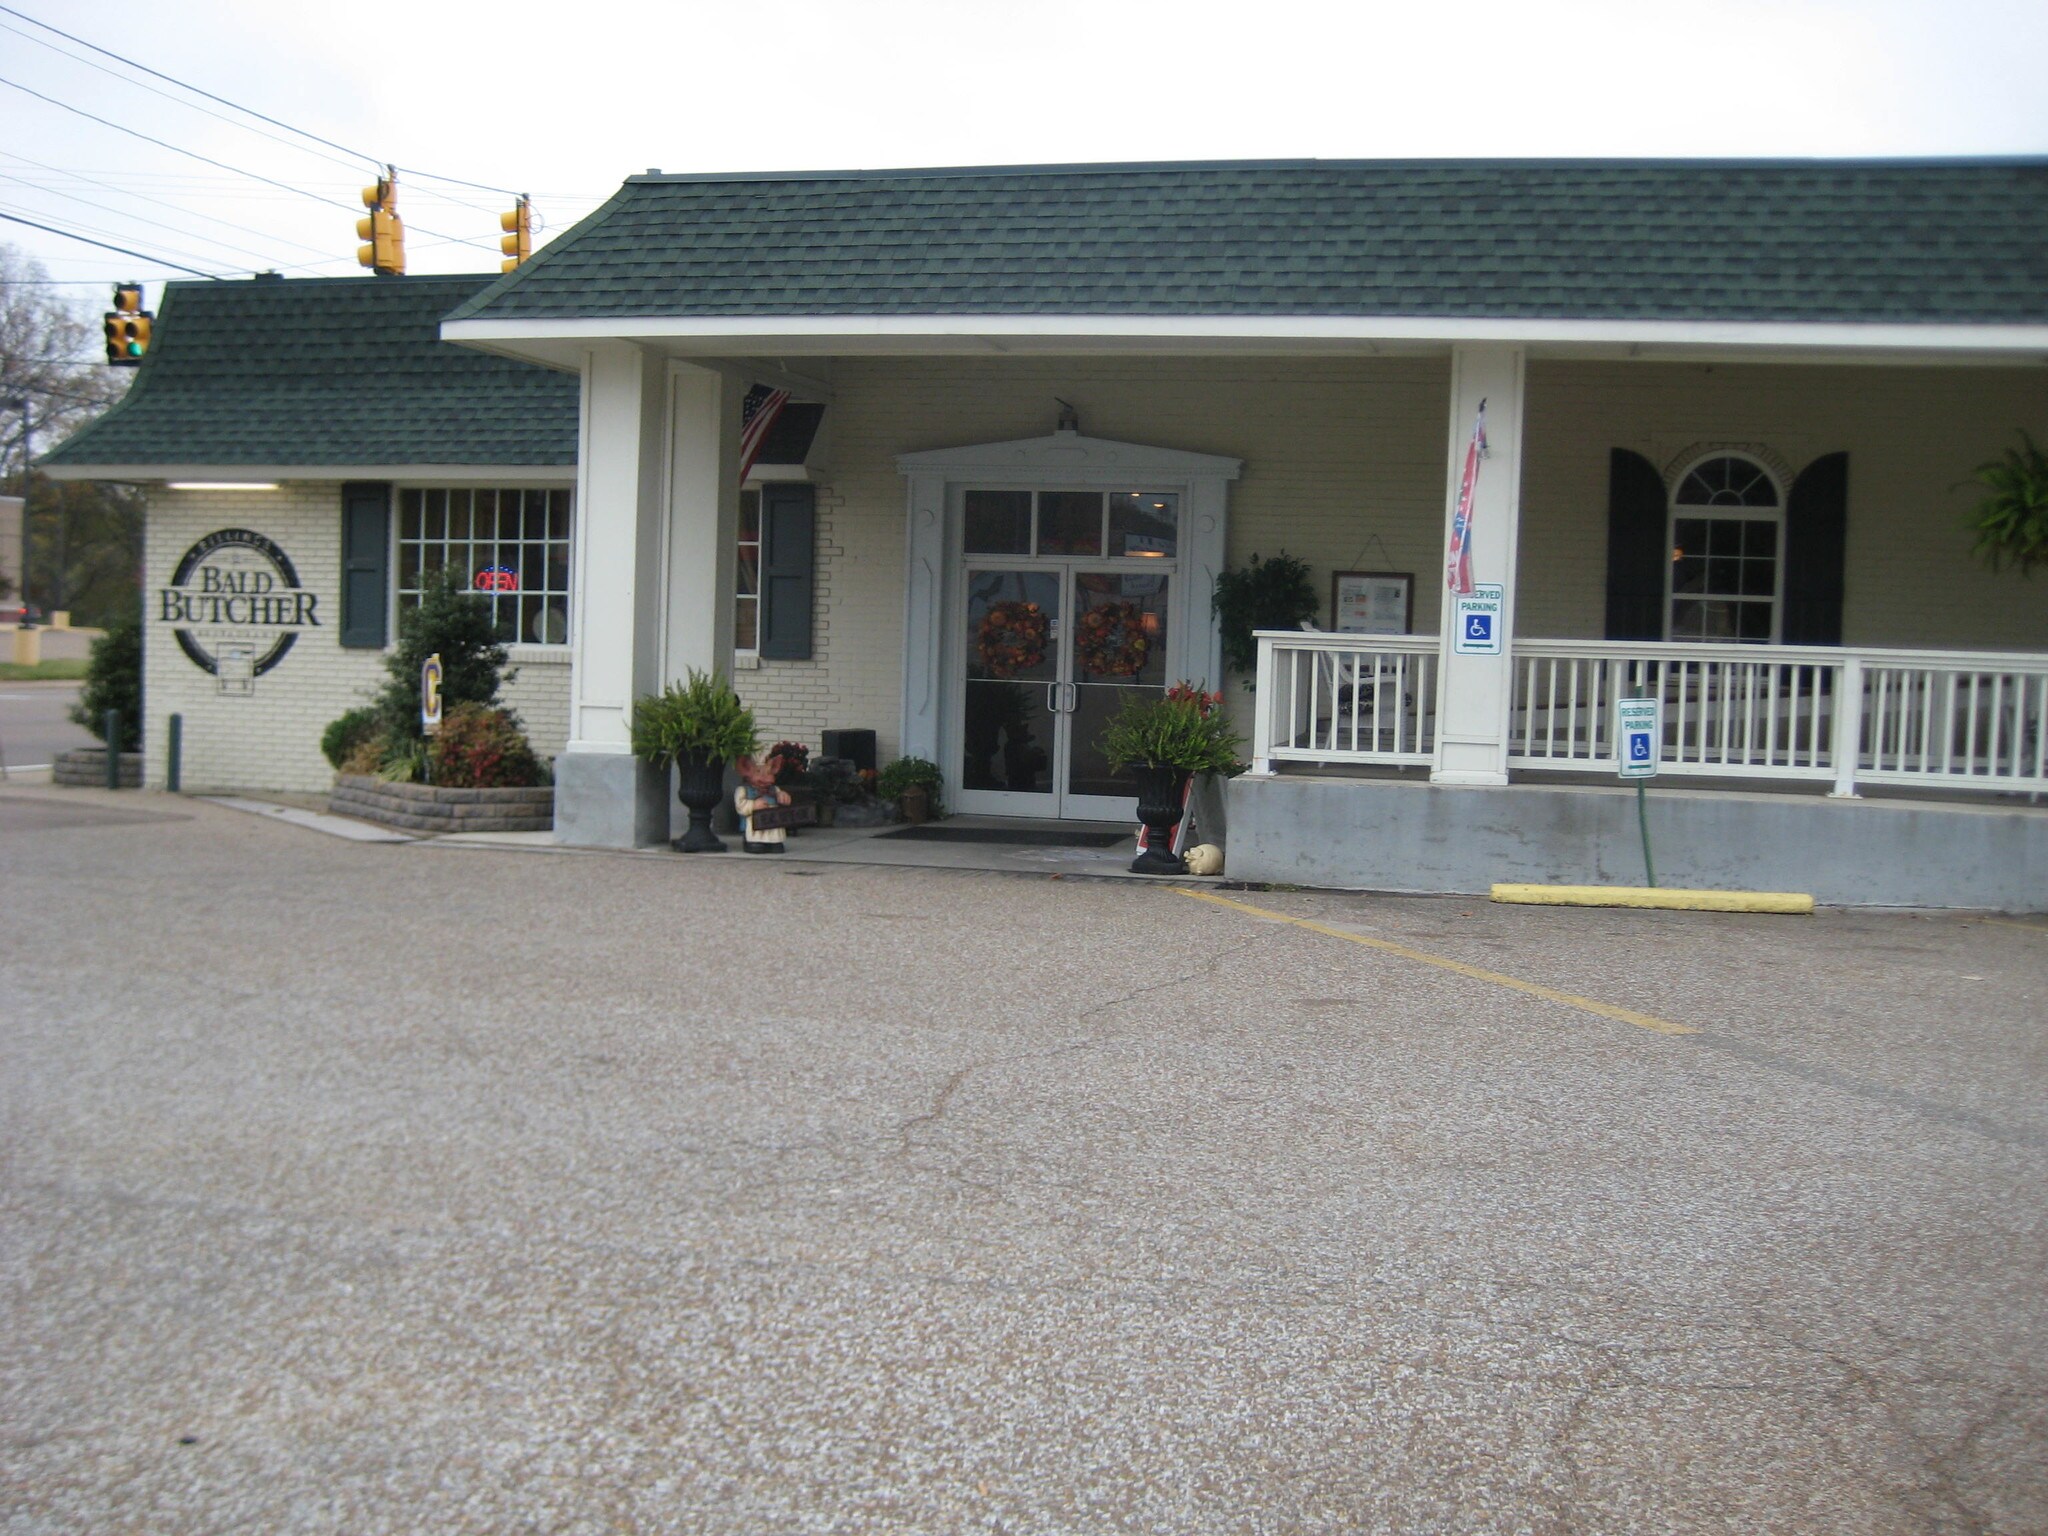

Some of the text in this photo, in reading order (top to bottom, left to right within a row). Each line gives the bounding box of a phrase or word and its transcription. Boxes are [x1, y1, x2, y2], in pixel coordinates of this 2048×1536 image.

[202, 566, 273, 594] BALD
[475, 571, 518, 592] OPEN
[1471, 590, 1500, 600] ERVED
[159, 588, 323, 627] BUTCHER
[1461, 602, 1498, 612] PARKING
[1625, 720, 1653, 730] PARKING
